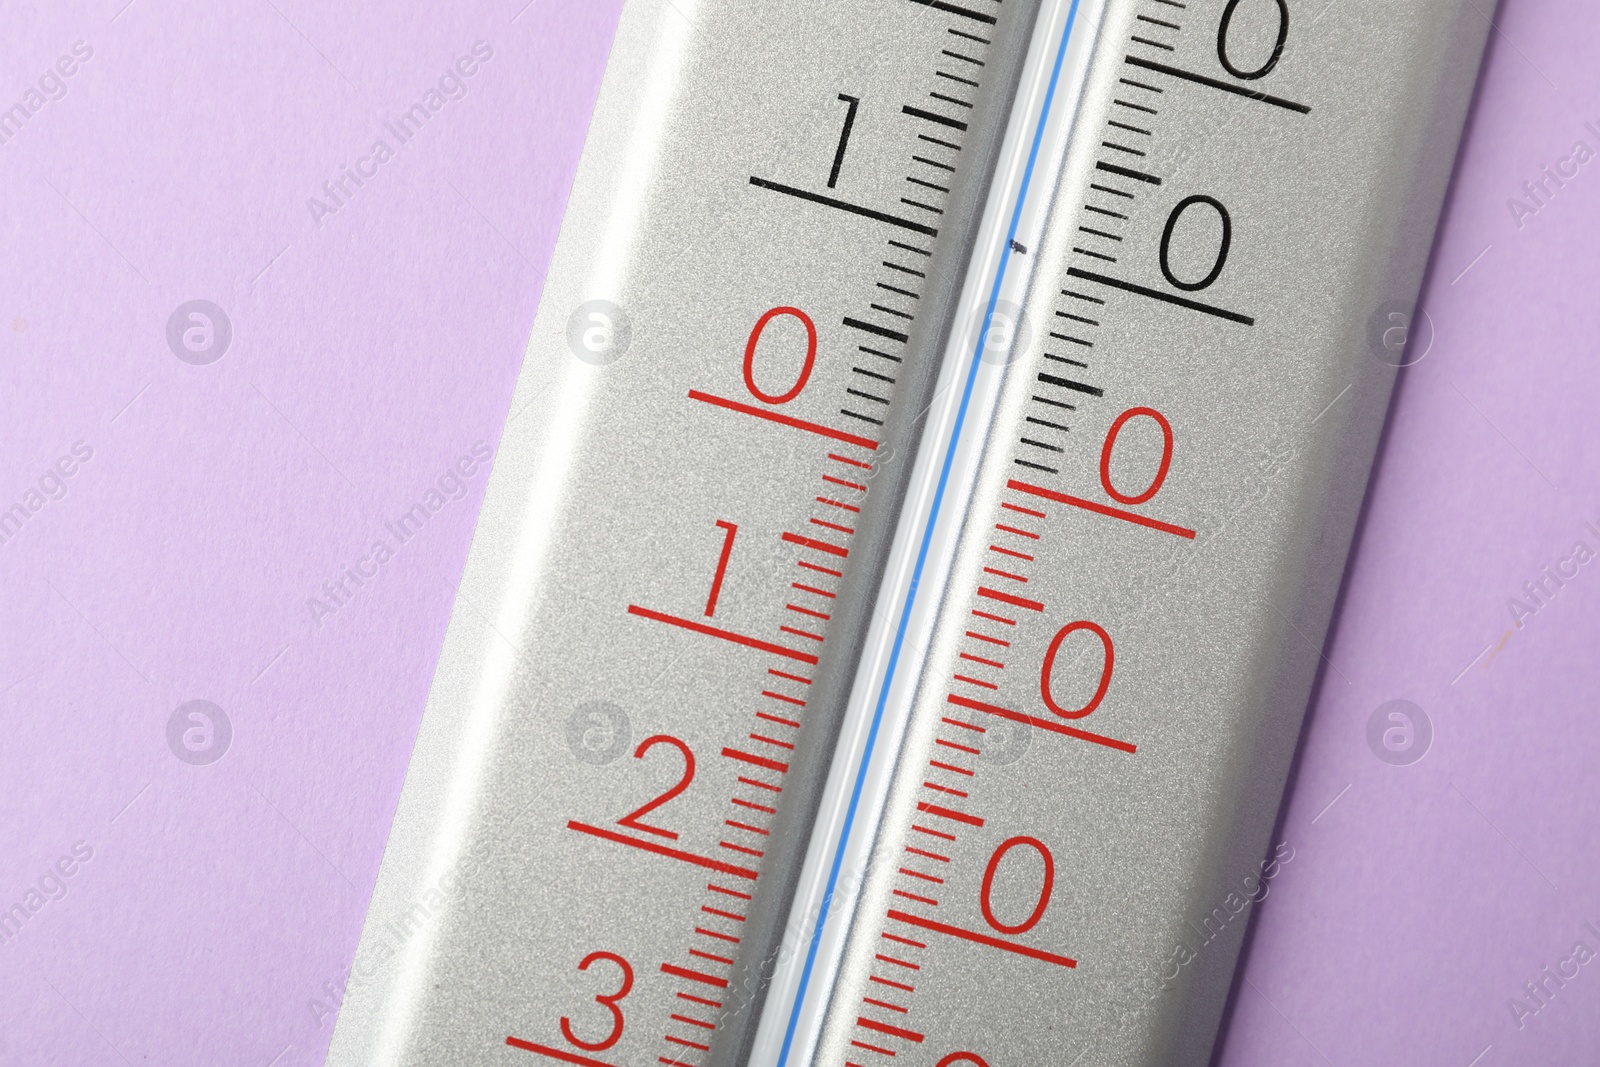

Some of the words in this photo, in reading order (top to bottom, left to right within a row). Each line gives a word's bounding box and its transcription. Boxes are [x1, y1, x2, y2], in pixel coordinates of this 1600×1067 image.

[1216, 0, 1290, 81] 0
[826, 93, 860, 189] 1
[1158, 194, 1232, 292] 0
[742, 306, 818, 405] 0
[1099, 406, 1174, 506] 0
[704, 519, 738, 618] 1
[1040, 620, 1115, 720] 0
[616, 734, 696, 841] 2
[979, 835, 1055, 935] 0
[559, 951, 635, 1052] 3
